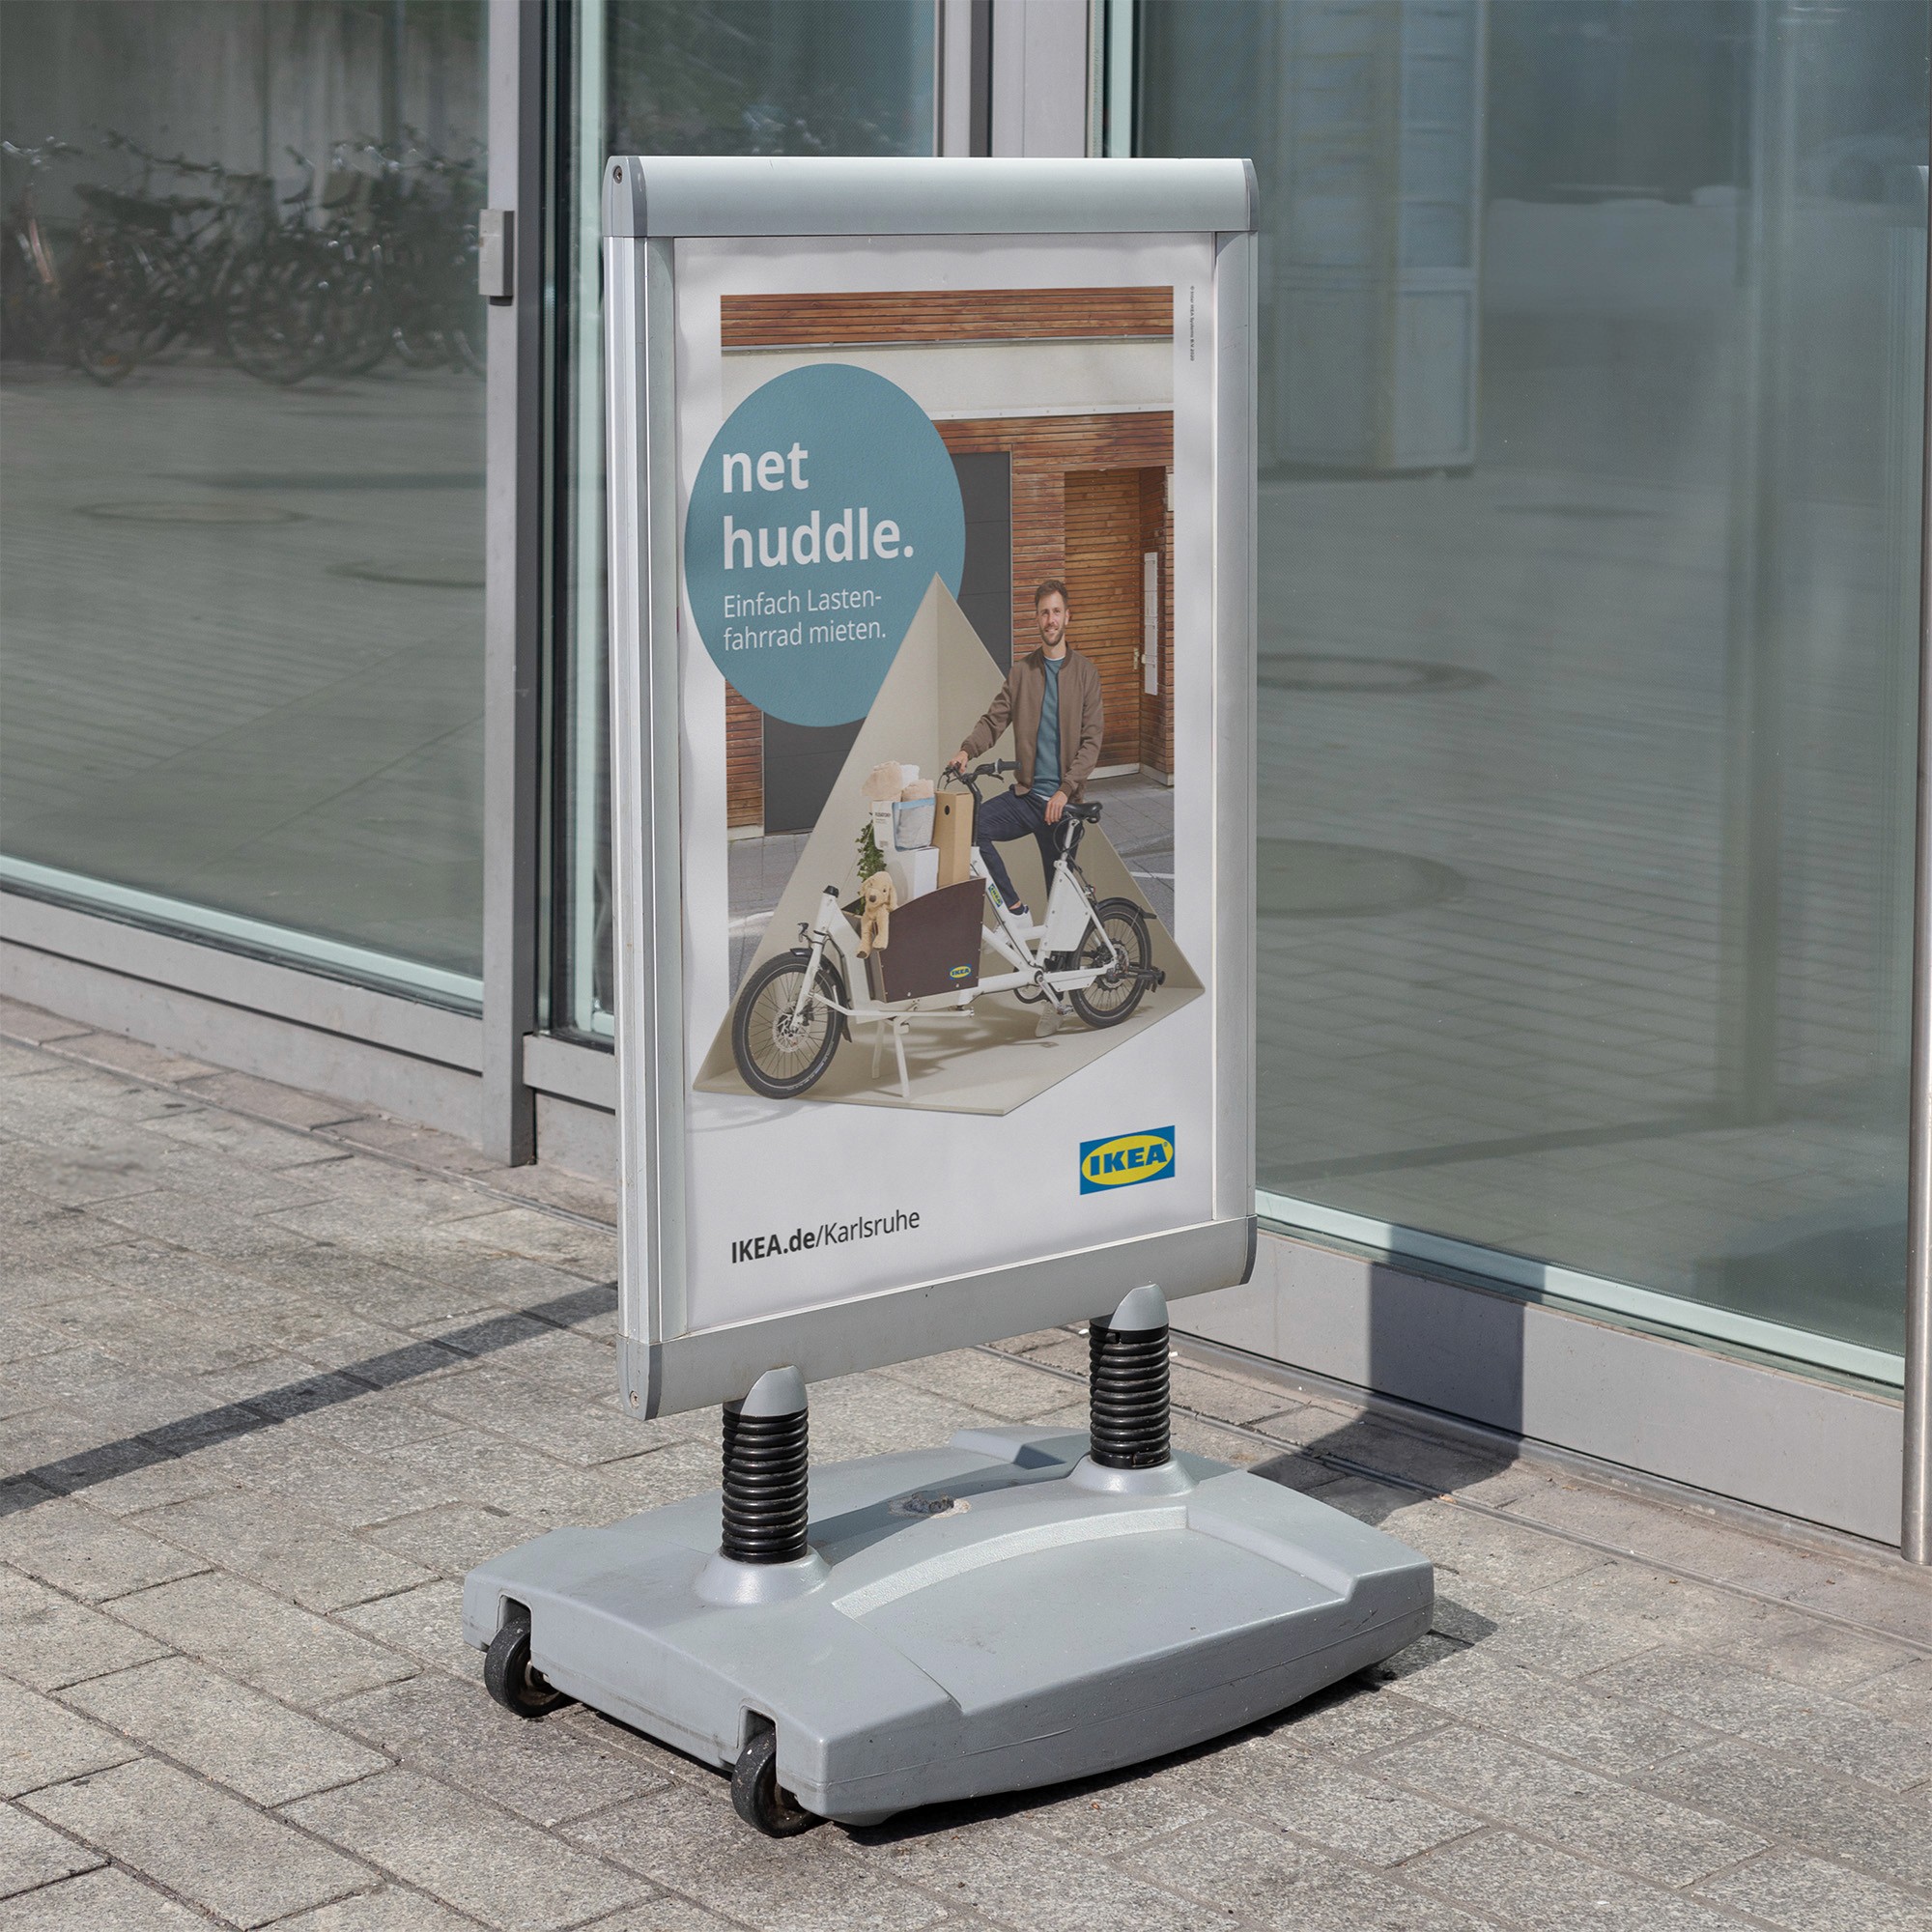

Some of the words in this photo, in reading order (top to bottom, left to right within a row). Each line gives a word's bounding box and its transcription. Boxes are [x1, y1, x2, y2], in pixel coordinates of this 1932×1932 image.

[723, 441, 810, 494] net
[723, 506, 915, 570] huddle.
[724, 589, 801, 619] Einfach
[808, 588, 882, 612] Lasten-
[724, 622, 802, 652] fahrrad
[810, 620, 887, 644] mieten.
[731, 1209, 921, 1264] IKEA.de/Karlsruhe
